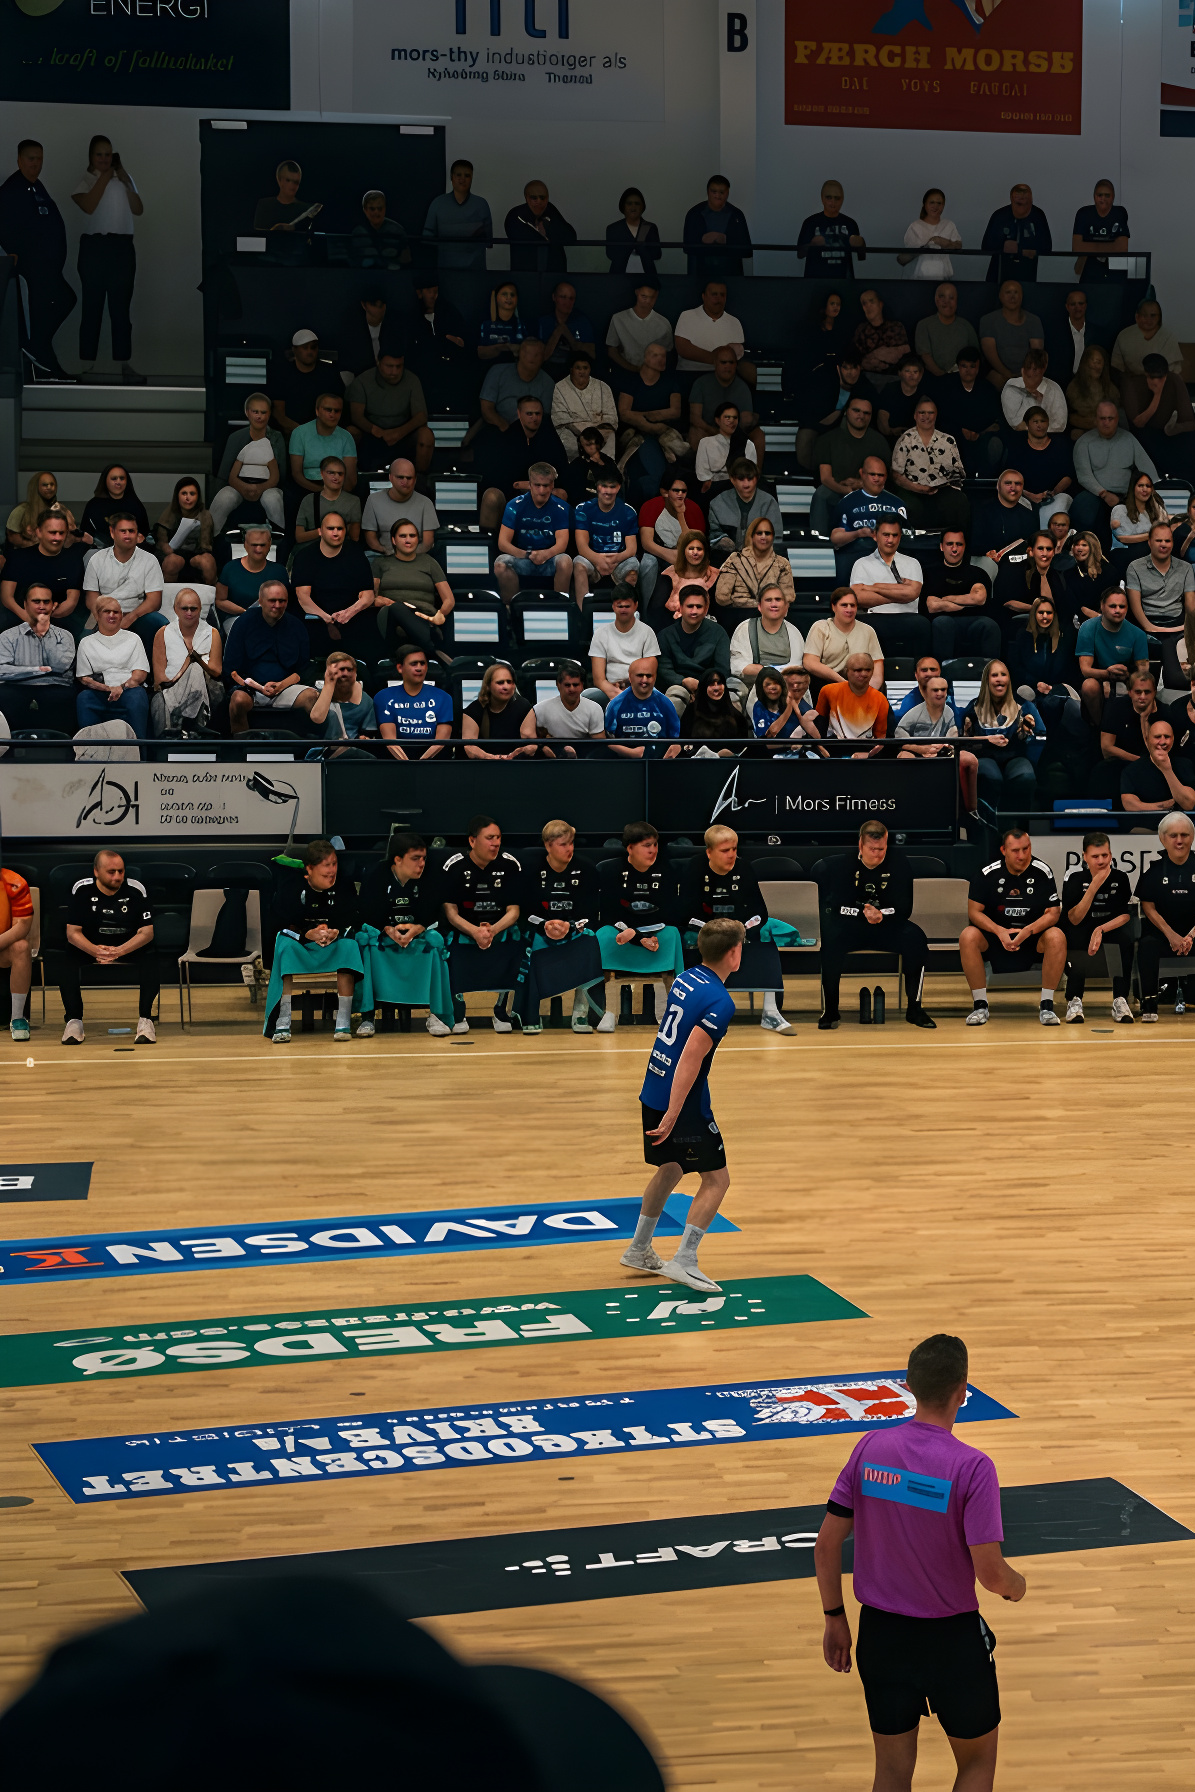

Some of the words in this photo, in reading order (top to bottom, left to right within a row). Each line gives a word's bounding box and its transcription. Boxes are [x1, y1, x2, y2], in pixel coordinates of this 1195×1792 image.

[727, 12, 749, 52] B
[390, 46, 480, 68] mors-thy
[793, 39, 932, 70] FÆRCH
[785, 794, 830, 811] Mors
[105, 1210, 620, 1265] DAVIDSEN
[71, 1312, 594, 1376] FREDSØ
[585, 1532, 820, 1571] CRAFT
